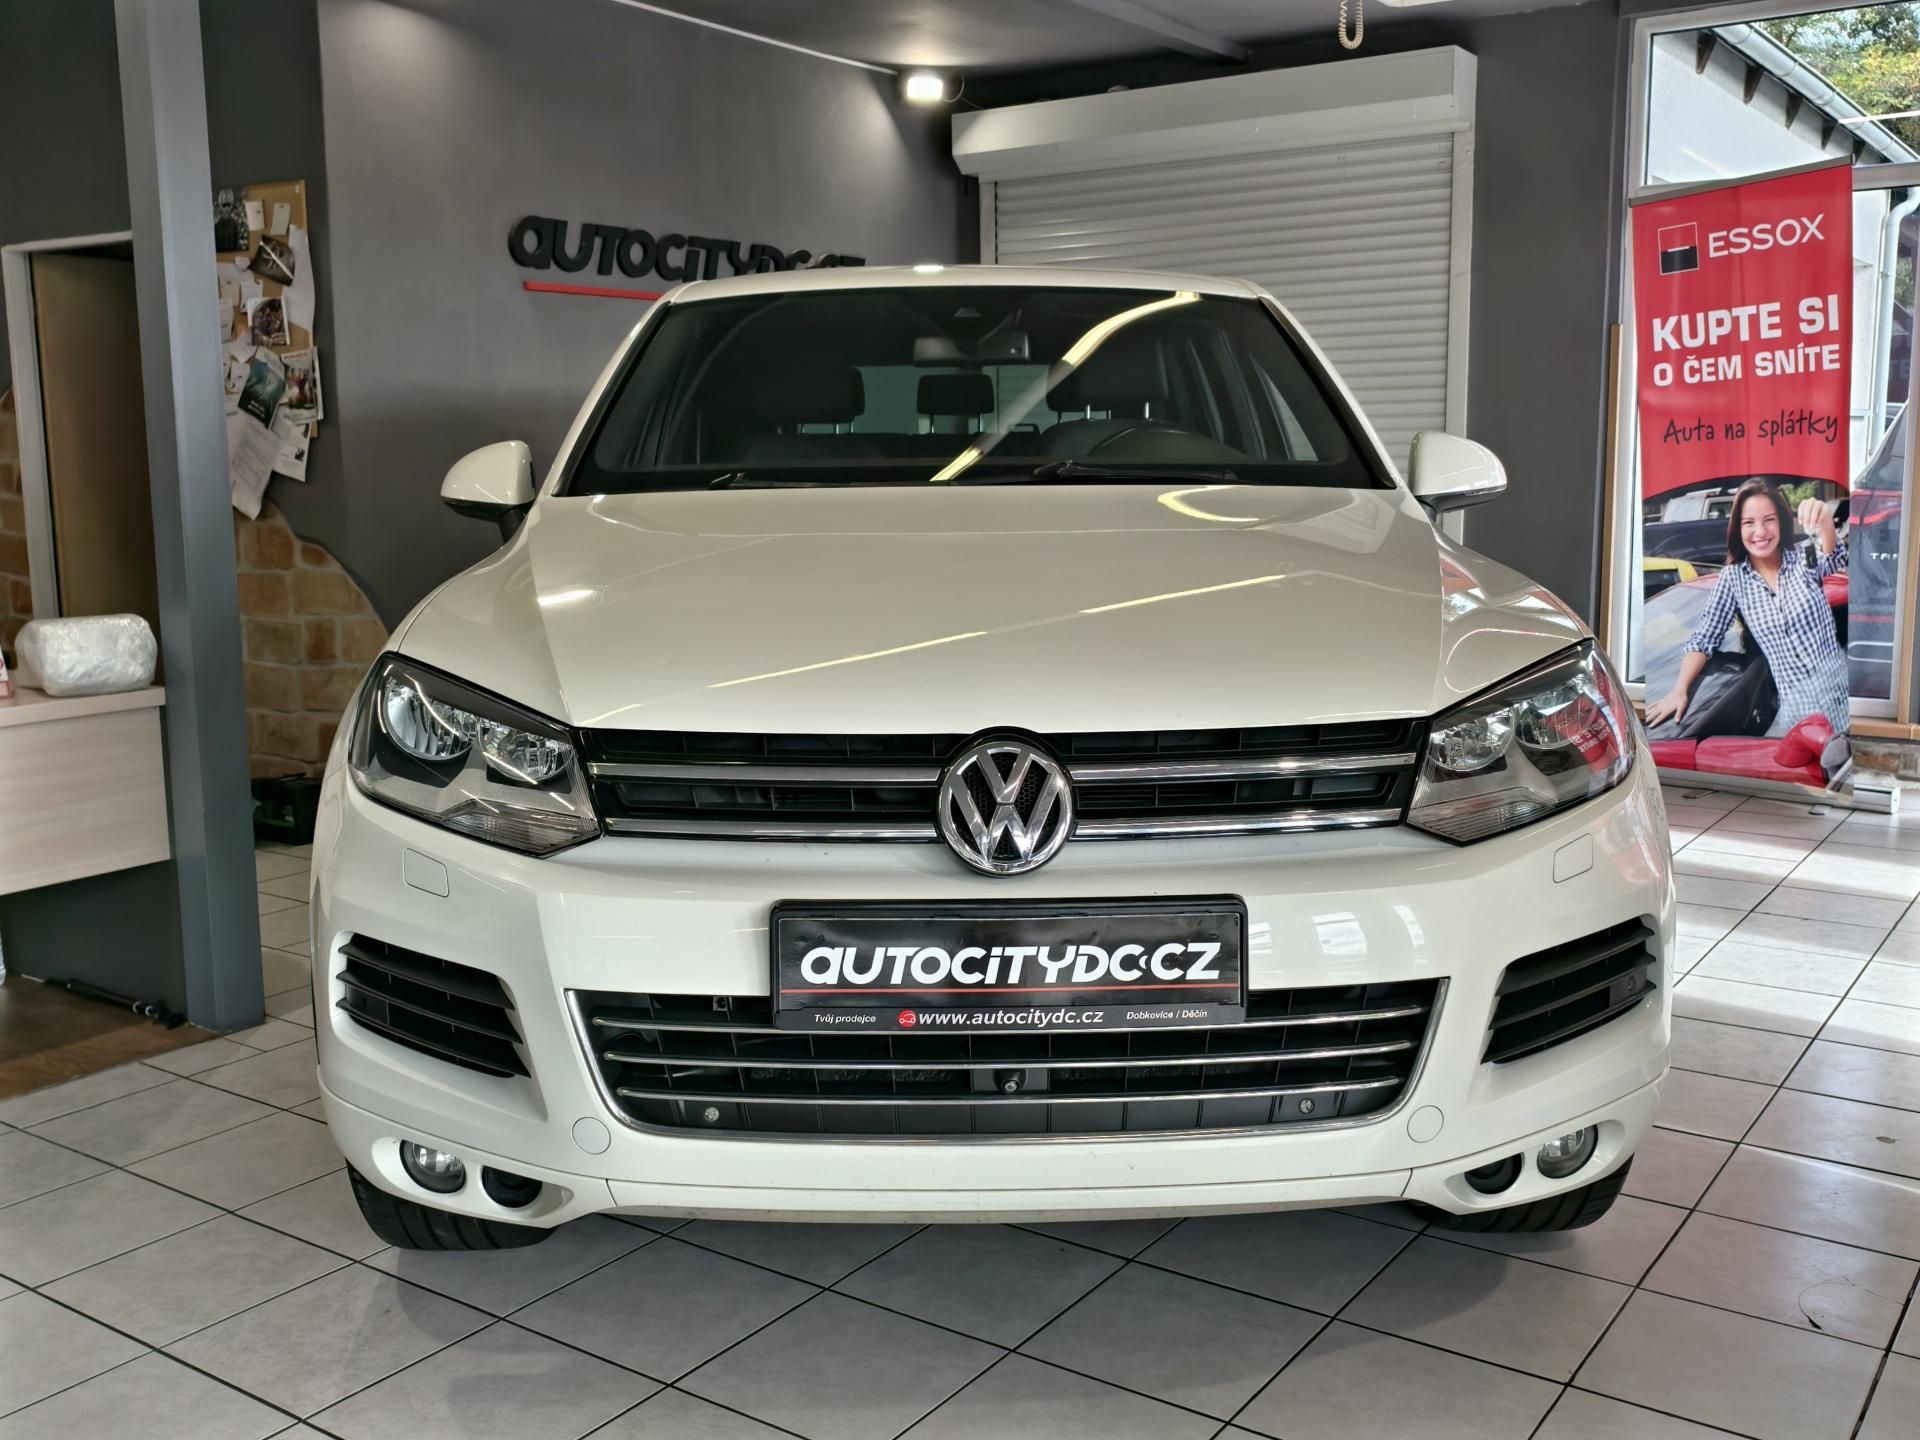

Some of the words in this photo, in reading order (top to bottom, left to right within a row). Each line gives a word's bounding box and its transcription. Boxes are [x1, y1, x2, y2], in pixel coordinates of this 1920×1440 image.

[1708, 214, 1825, 258] ESSOX
[1652, 302, 1782, 352] KUPTE
[1798, 294, 1840, 334] SI
[1653, 362, 1673, 387] O
[1683, 355, 1742, 384] ČEM
[1754, 342, 1840, 377] SNÍTE
[1664, 417, 1715, 444] Auta
[1724, 423, 1745, 441] na
[1758, 409, 1839, 446] splátky
[814, 1013, 834, 1024] Tvůj
[835, 1014, 876, 1024] prodejce
[918, 1008, 1104, 1028] www.autocitydc.cz
[1126, 1010, 1174, 1020] Dobkovice
[1181, 1008, 1208, 1018] Děčín
